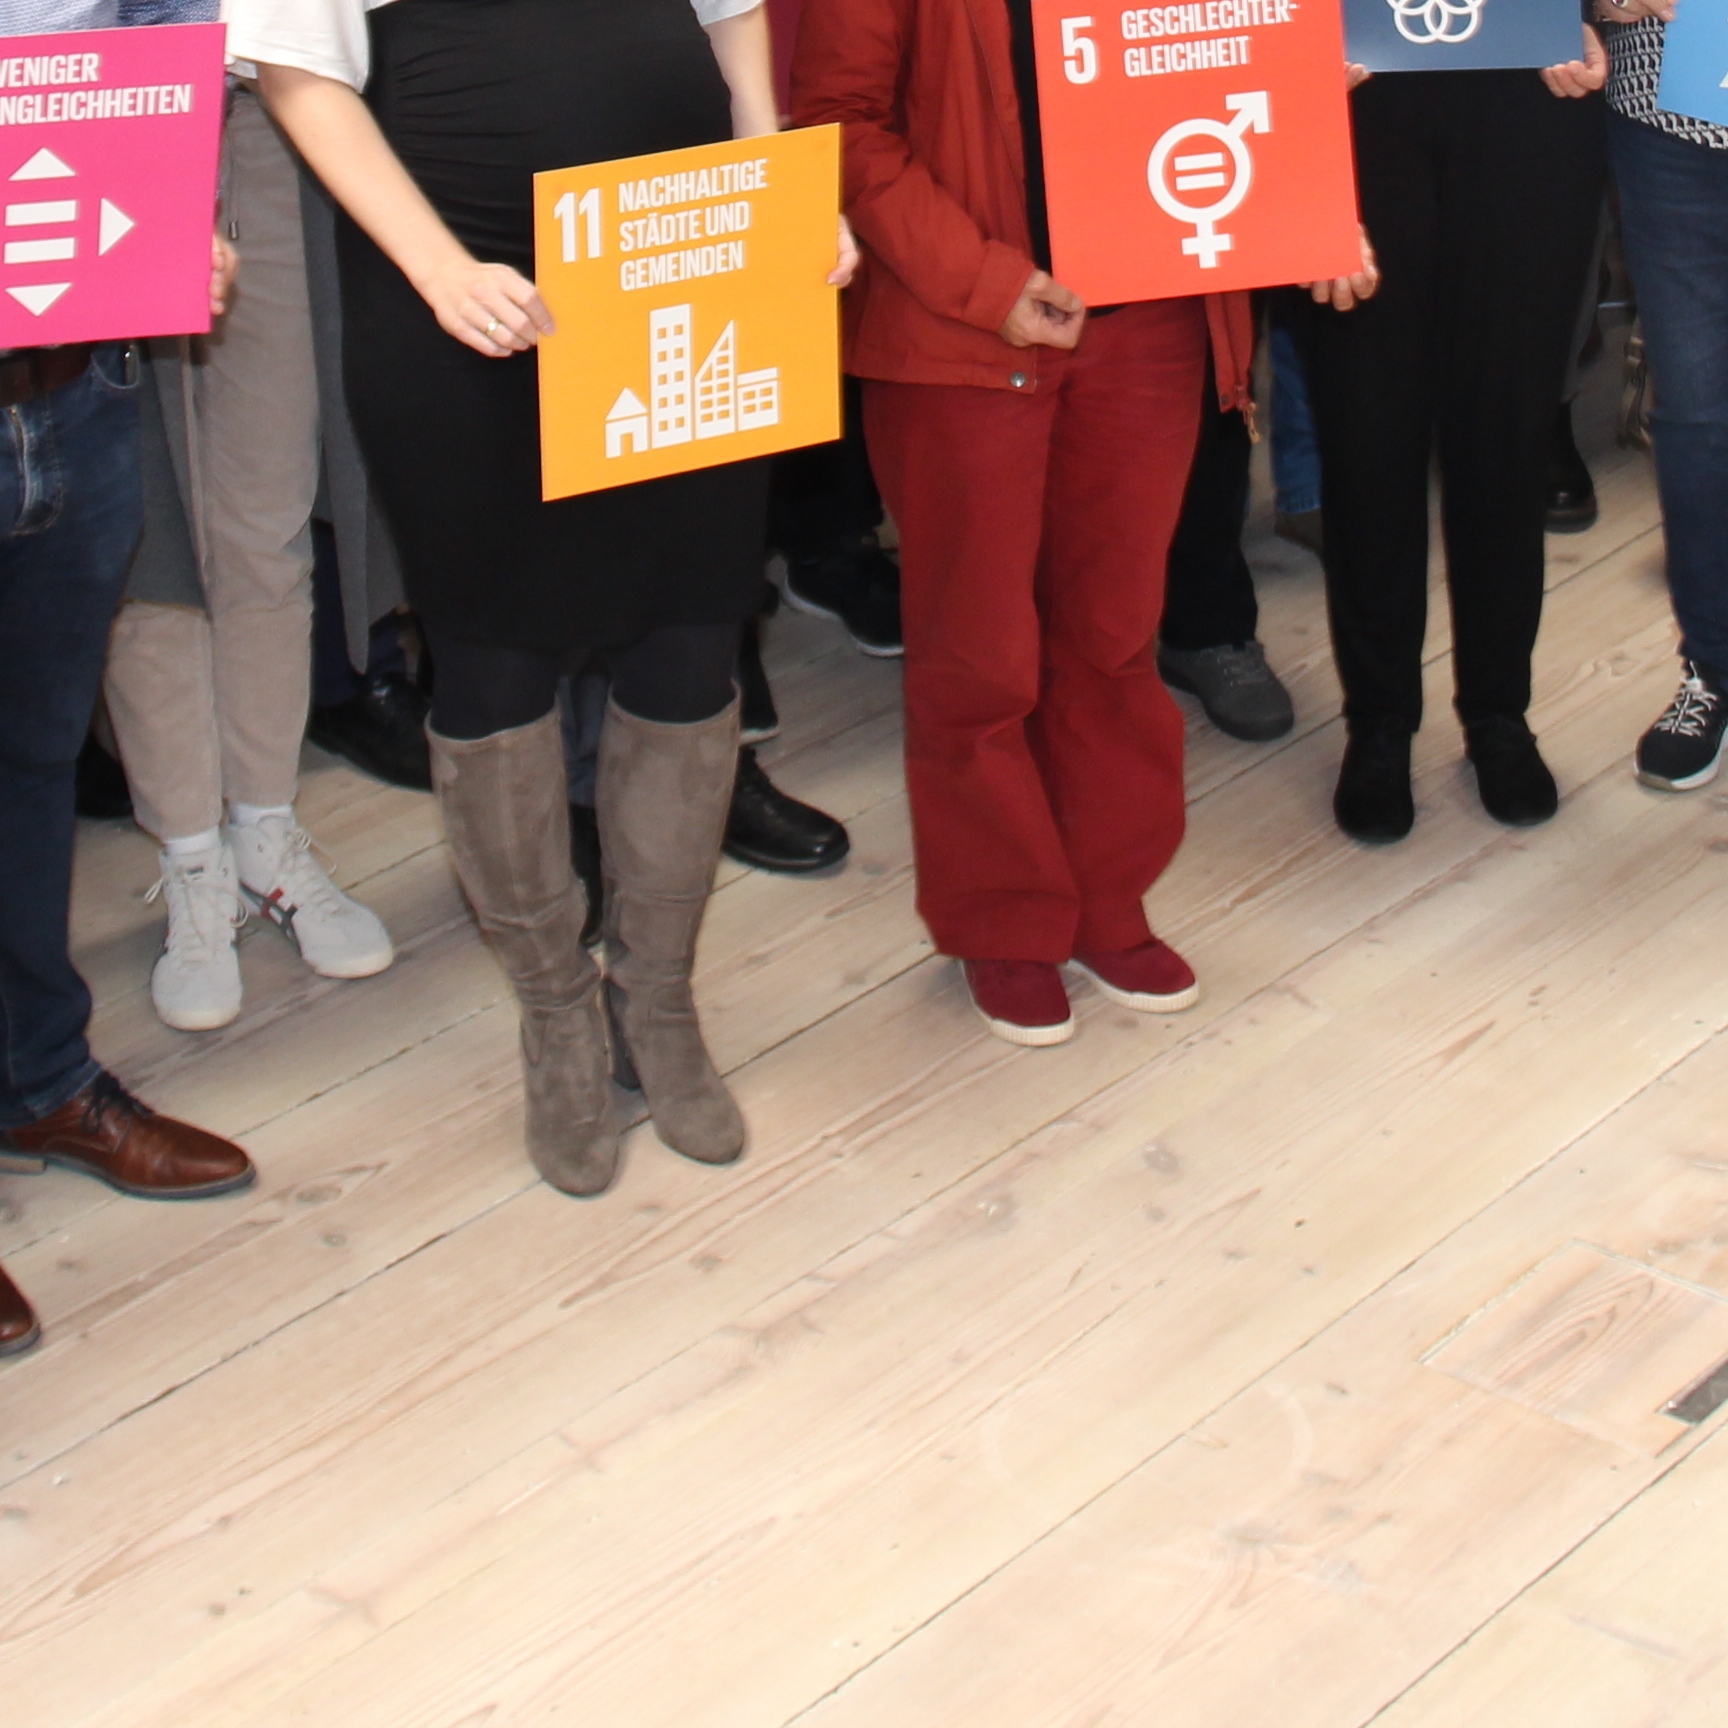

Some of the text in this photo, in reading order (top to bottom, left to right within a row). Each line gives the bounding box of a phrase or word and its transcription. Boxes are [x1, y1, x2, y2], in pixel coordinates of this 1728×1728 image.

[1061, 16, 1098, 84] 5
[1124, 36, 1251, 77] GLEICHHEIT
[618, 158, 768, 213] NACHHALTIGE
[554, 188, 602, 263] 11
[619, 201, 751, 252] STÄDTE UND
[620, 240, 744, 292] GEMEINDEN
